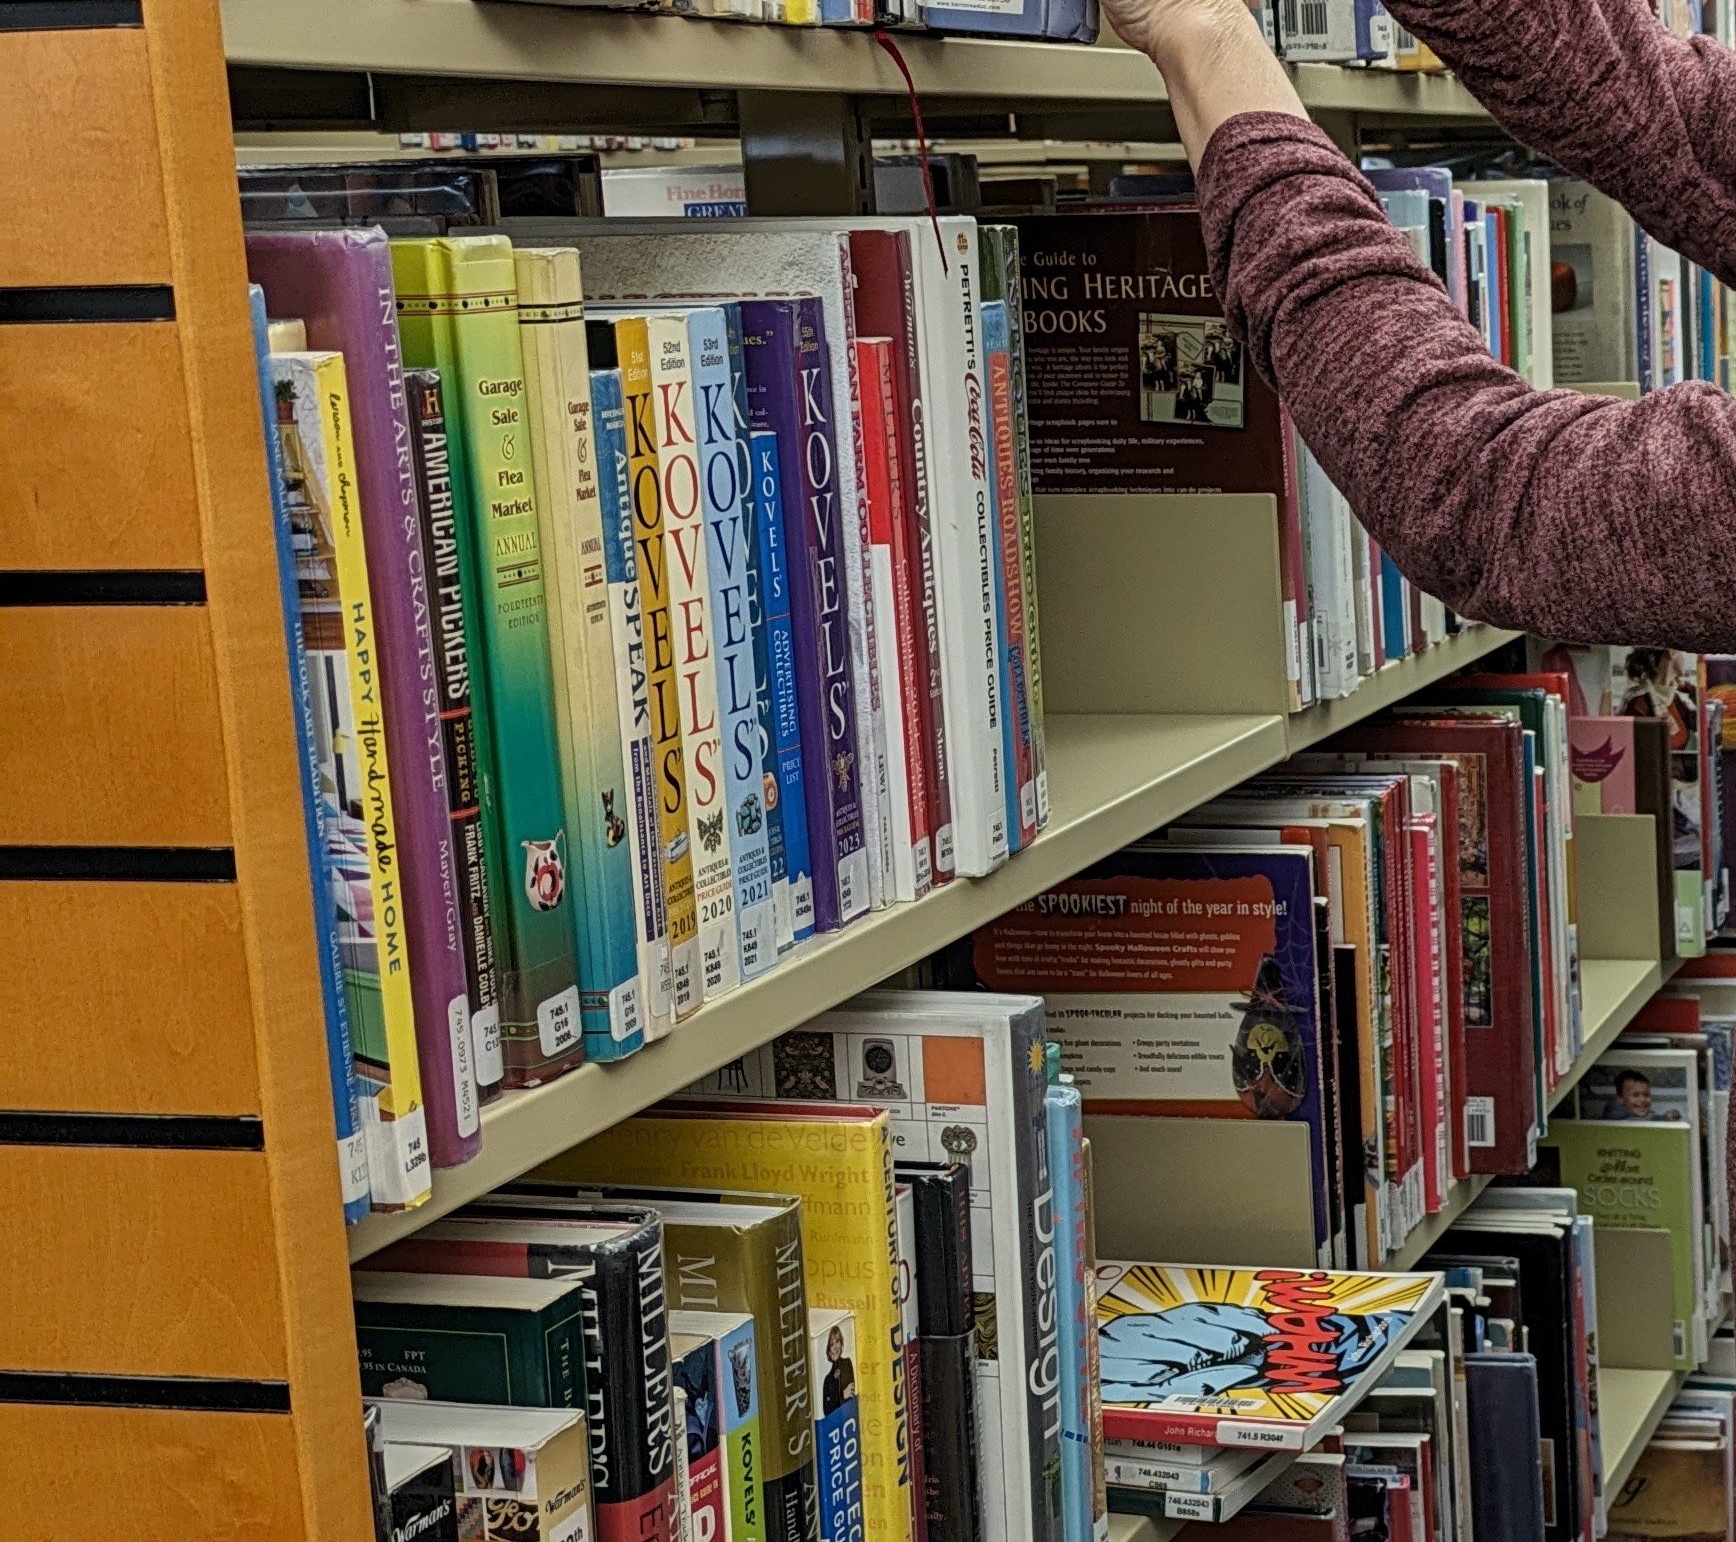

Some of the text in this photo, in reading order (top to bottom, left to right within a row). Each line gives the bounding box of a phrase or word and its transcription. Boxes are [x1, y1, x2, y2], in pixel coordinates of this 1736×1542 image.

[666, 186, 705, 200] Fine
[1034, 251, 1097, 267] Guide to
[1024, 309, 1107, 334] BOOKS
[663, 340, 681, 355] 52nd
[703, 338, 718, 352] 53rd
[661, 357, 686, 371] Edition
[700, 353, 724, 368] Edition
[478, 378, 523, 396] Garage
[491, 409, 519, 424] Sale
[567, 401, 590, 416] Garage
[497, 470, 523, 486] Flea
[578, 469, 591, 483] Flea
[576, 485, 596, 500] Market
[992, 366, 1023, 636] ANTIQUES ROADSHOW
[492, 499, 534, 518] Market
[495, 532, 537, 556] ANNUAL
[423, 433, 471, 700] AMERICAN PICKERS
[612, 448, 649, 728] Antique SPEAK
[508, 613, 540, 629] EDITION
[774, 630, 788, 738] COLLECTIBLES
[781, 630, 797, 733] ADVERTISING
[782, 759, 800, 772] PRICE
[786, 772, 800, 785] LIST
[352, 603, 403, 976] HAPPY Handmade HOME
[838, 837, 861, 858] 2023
[438, 839, 458, 953] Mayer/Gray
[741, 881, 769, 906] 2021
[702, 895, 732, 923] 2020
[1038, 893, 1288, 917] SPOOKIEST night of the year in style!
[672, 911, 697, 939] 2019
[742, 929, 757, 940] 745.1
[1096, 944, 1198, 954] Spooky Halloween Crafts
[680, 1161, 870, 1187] Frank Lloyd Wright
[1583, 1186, 1661, 1210] SOCKS
[816, 1292, 877, 1311] Russell
[1030, 1186, 1061, 1440] Design
[636, 1242, 674, 1476] MILLER'S
[1164, 1427, 1217, 1438] John Richar
[1237, 1432, 1258, 1441] 741.5
[828, 1427, 844, 1495] PRICE
[741, 1431, 756, 1526] KOVELS'
[545, 1479, 586, 1513] Warman's
